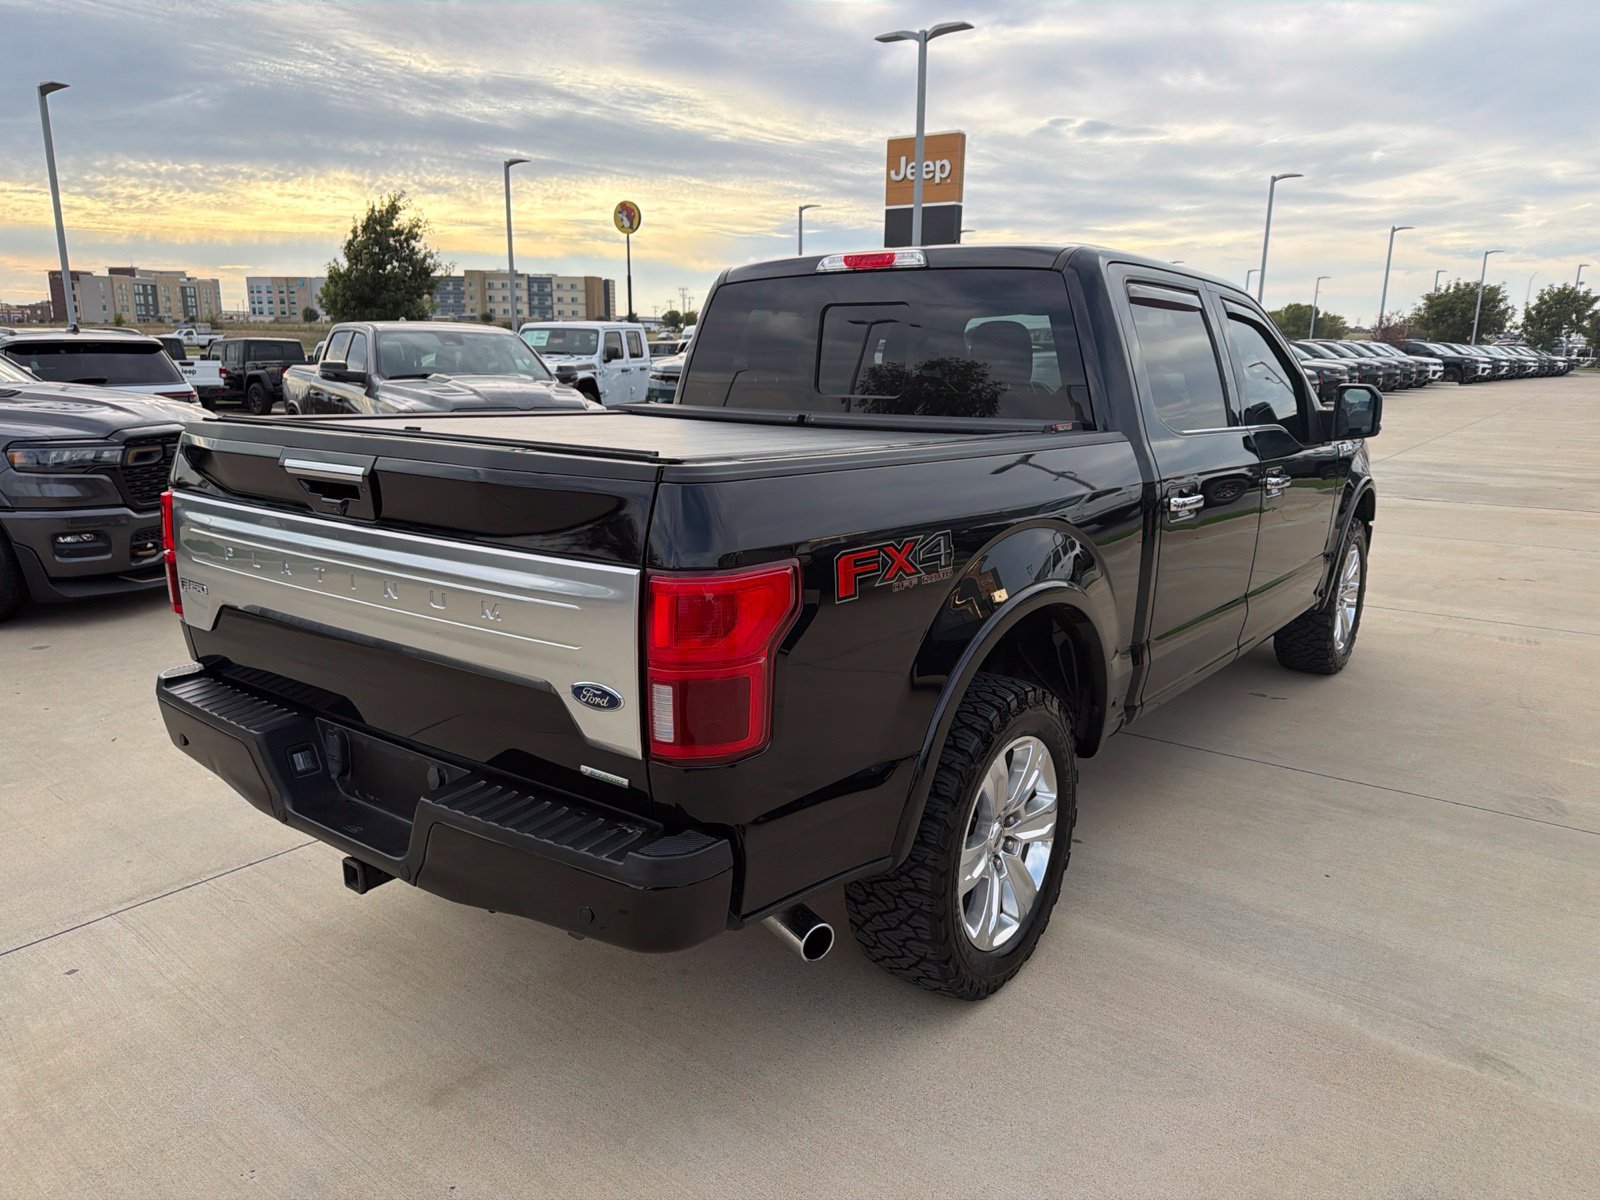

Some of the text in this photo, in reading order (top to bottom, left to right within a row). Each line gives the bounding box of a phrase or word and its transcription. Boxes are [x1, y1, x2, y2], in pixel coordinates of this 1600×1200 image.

[890, 156, 952, 184] Jeep
[224, 545, 502, 622] PLATINUM
[834, 530, 954, 604] FX4
[892, 568, 954, 593] OFF ROAD
